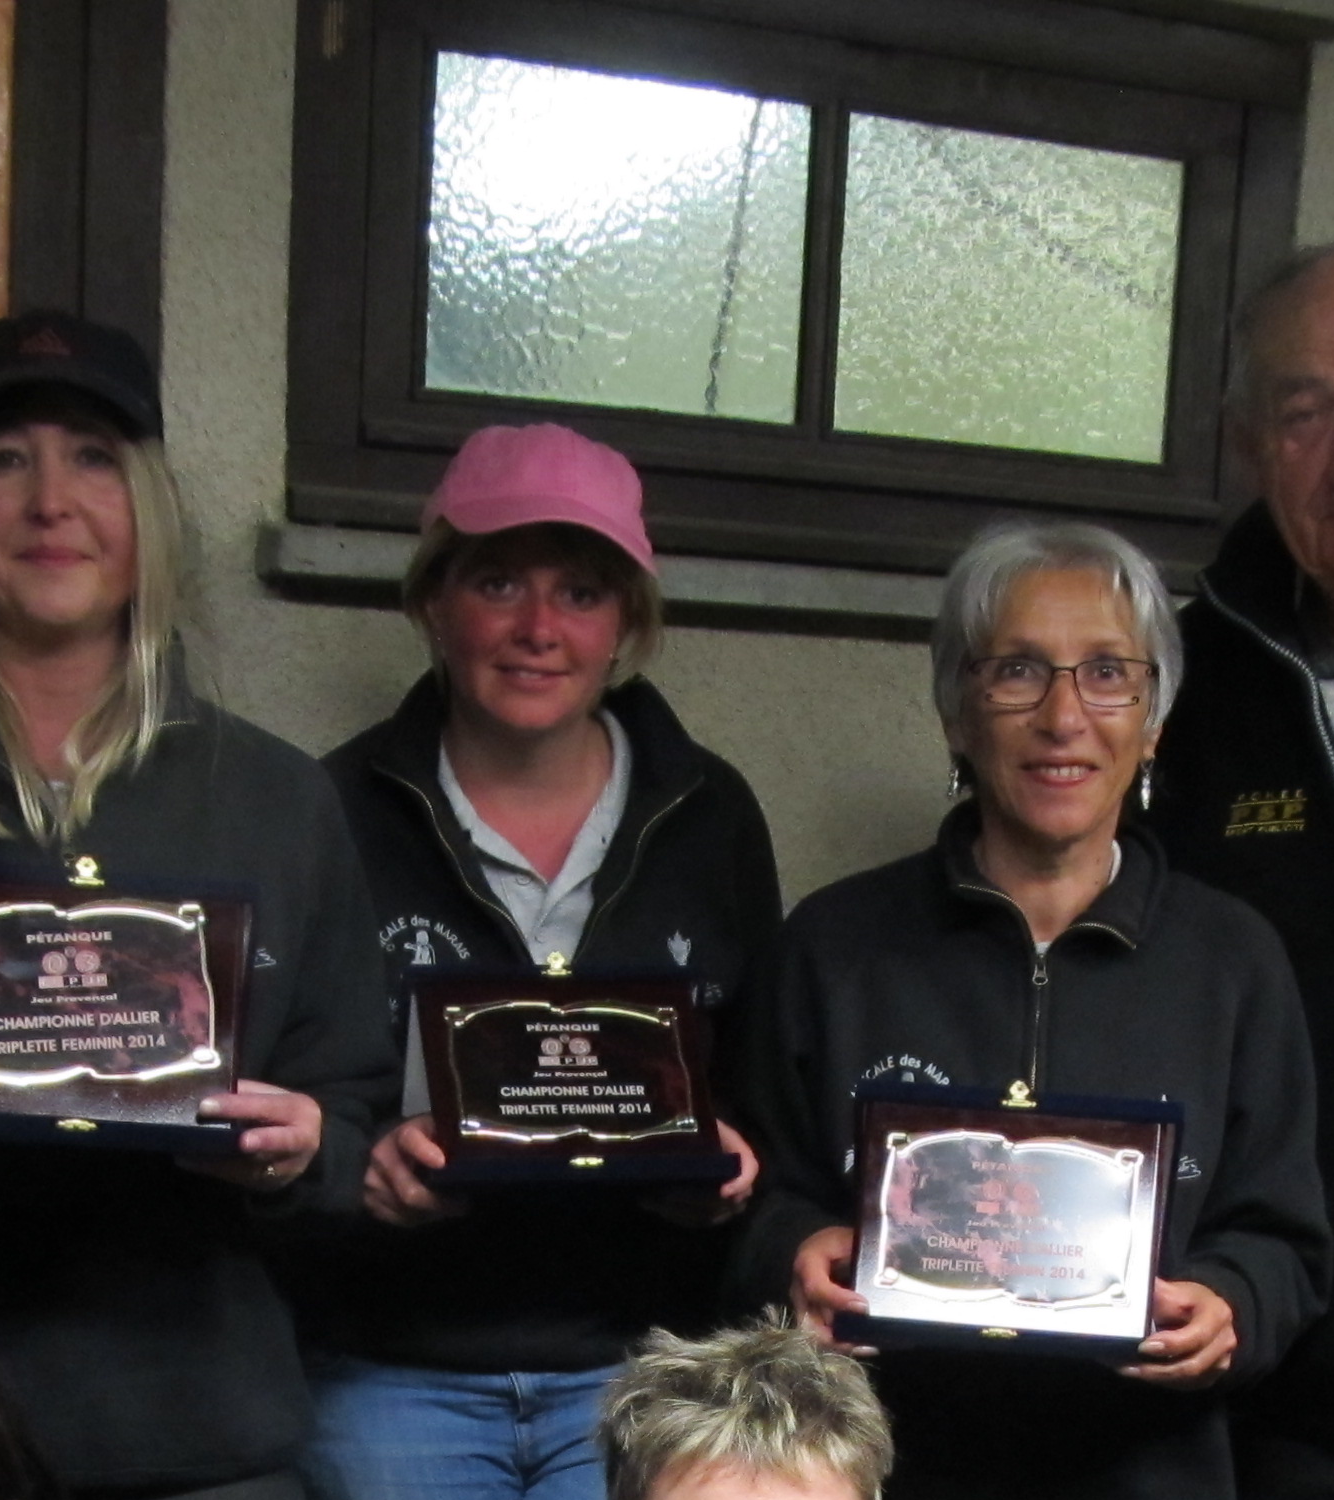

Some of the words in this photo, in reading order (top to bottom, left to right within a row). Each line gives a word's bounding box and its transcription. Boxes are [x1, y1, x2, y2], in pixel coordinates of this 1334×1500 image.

[26, 931, 113, 944] PÉTANQUE
[410, 914, 431, 928] des
[433, 922, 471, 960] MARAIS
[30, 996, 53, 1004] Jeu
[56, 993, 117, 1004] Provençal
[100, 1011, 160, 1025] D'ALLIER
[526, 1022, 600, 1032] PÉTANQUE
[62, 1036, 123, 1051] FEMININ
[127, 1034, 166, 1048] 2014
[899, 1053, 922, 1069] des
[500, 1086, 589, 1097] CHAMPIONNE
[593, 1085, 645, 1096] D'ALLIER
[499, 1104, 558, 1115] TRIPLETTE
[562, 1103, 615, 1114] FEMININ
[618, 1103, 652, 1114] 2014
[921, 1257, 985, 1273] TRIPLETTE
[1050, 1266, 1085, 1280] 2014
